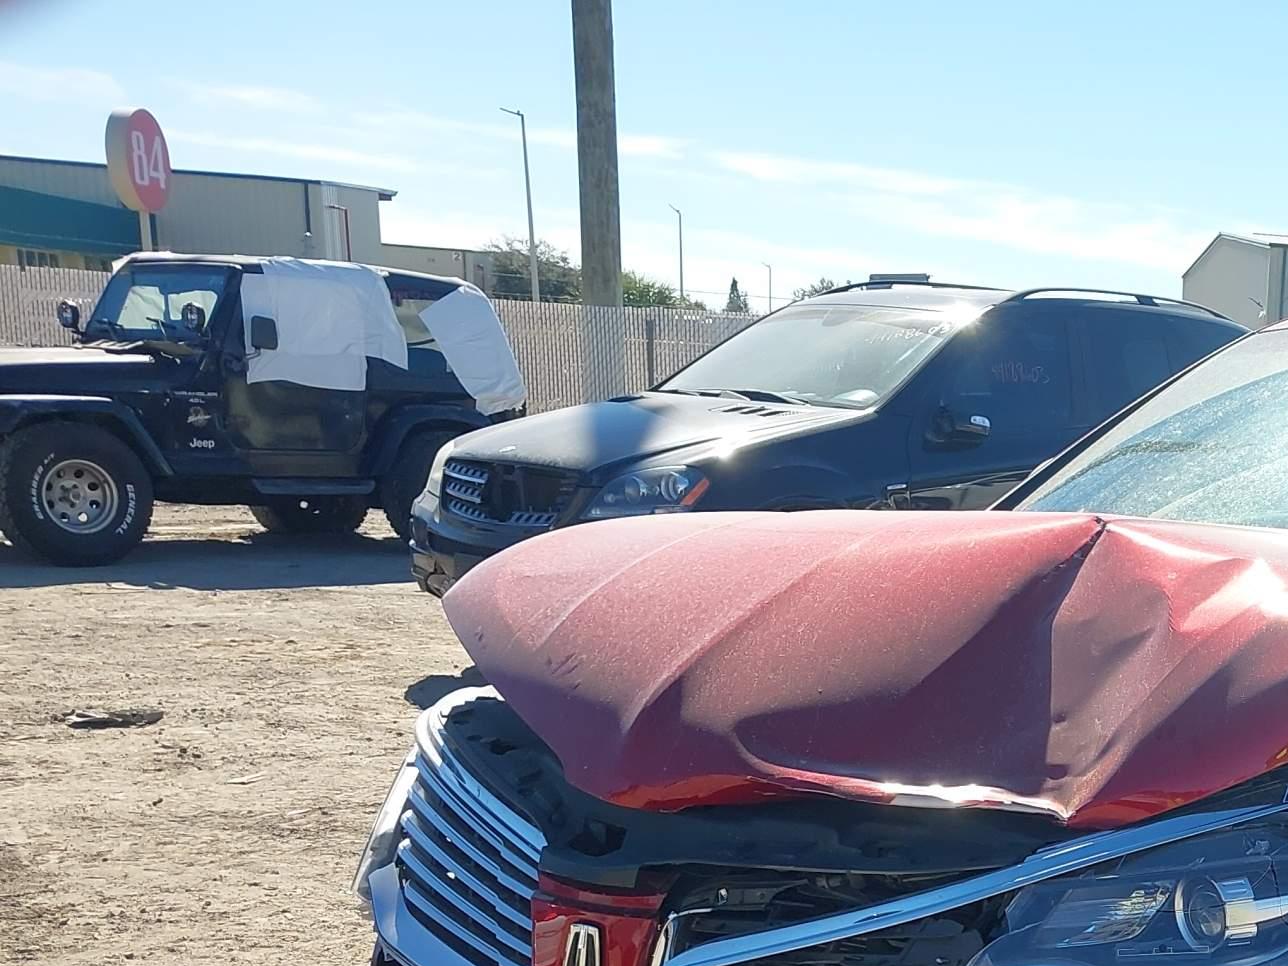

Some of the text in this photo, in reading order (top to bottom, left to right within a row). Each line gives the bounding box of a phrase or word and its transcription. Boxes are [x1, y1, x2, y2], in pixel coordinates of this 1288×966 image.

[131, 131, 166, 189] 84
[189, 438, 215, 448] Jeep
[115, 484, 136, 534] GENERAL
